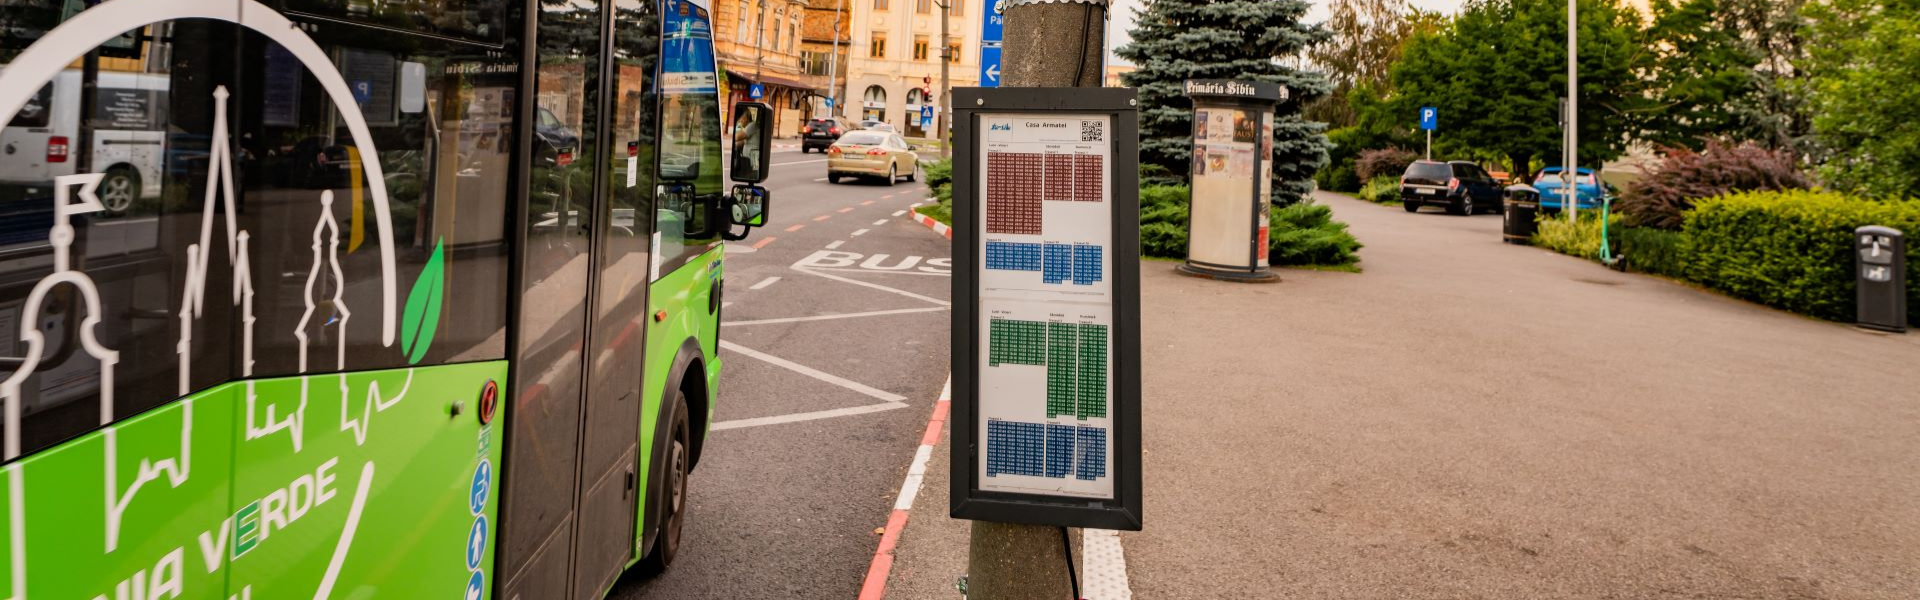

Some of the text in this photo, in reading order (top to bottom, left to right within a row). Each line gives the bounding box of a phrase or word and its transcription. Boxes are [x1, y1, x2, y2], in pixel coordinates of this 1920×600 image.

[1225, 81, 1256, 95] Sibiu
[1424, 109, 1433, 123] P
[794, 249, 951, 273] BUS
[198, 456, 339, 574] VERDE
